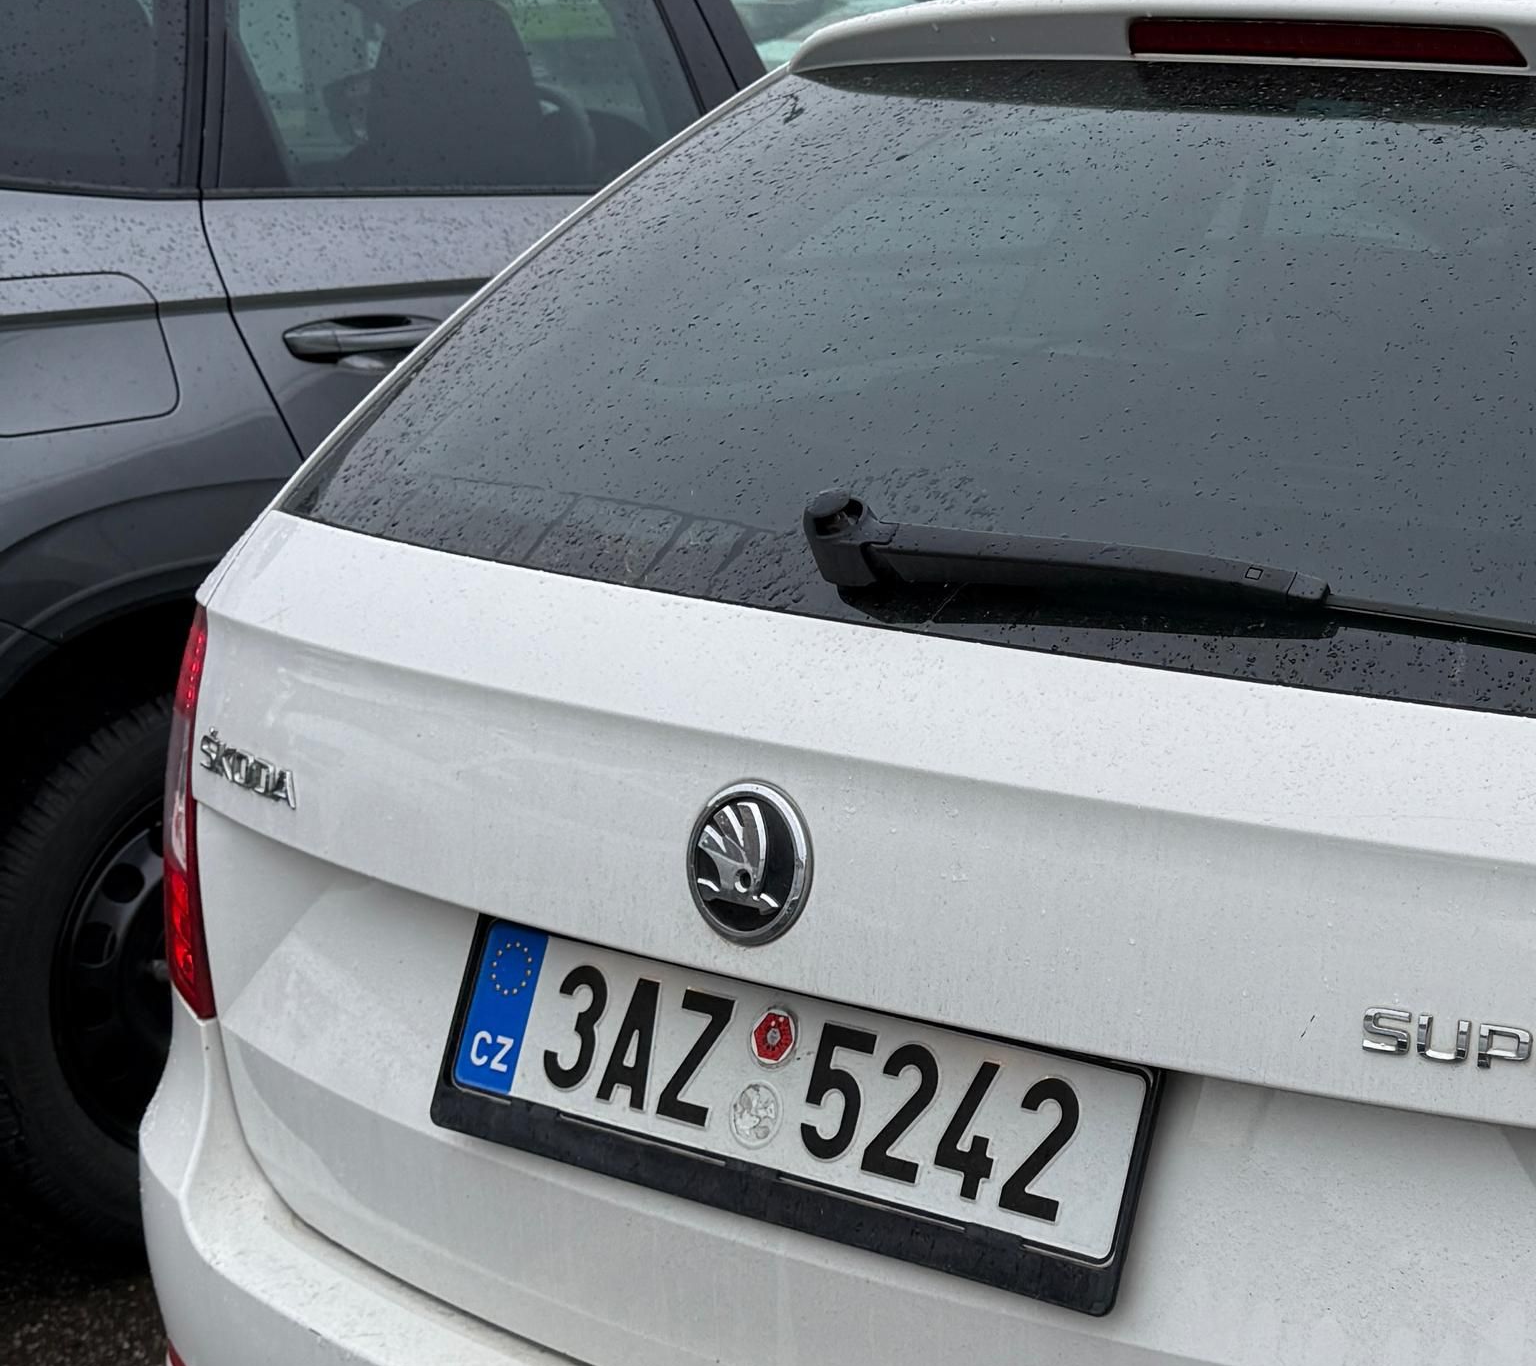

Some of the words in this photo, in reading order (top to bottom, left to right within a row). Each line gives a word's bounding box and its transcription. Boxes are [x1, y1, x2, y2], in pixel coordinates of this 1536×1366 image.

[200, 726, 296, 810] ŠKODA
[470, 1031, 514, 1073] CZ
[543, 964, 737, 1128] 3AZ
[800, 1022, 1080, 1223] 5242
